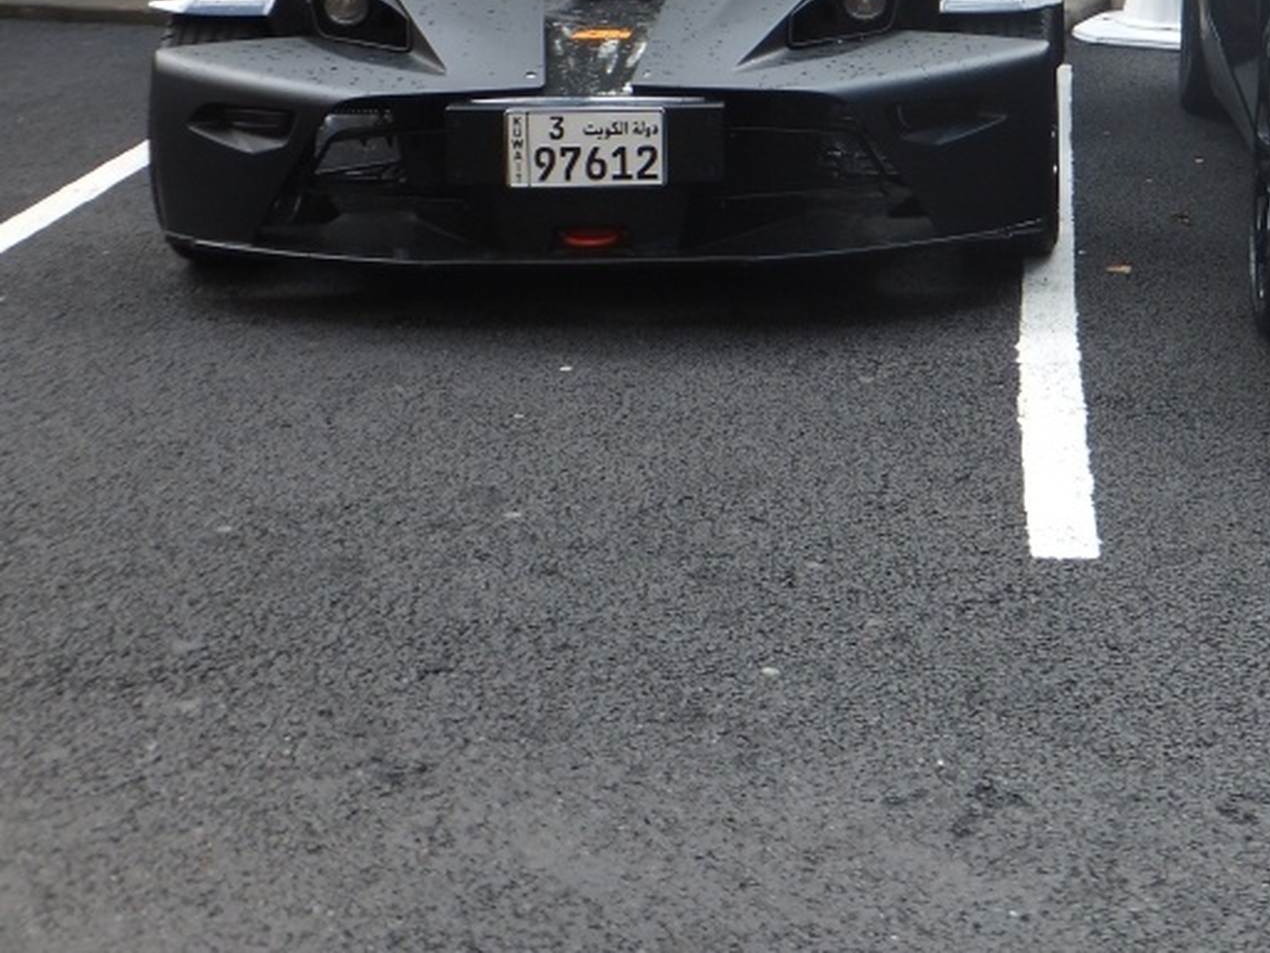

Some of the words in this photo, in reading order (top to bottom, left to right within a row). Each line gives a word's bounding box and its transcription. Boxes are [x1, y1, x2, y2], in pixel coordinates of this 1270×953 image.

[549, 116, 565, 140] 3
[583, 121, 629, 140] الكويت
[632, 121, 659, 138] دولة
[534, 145, 659, 181] 97612
